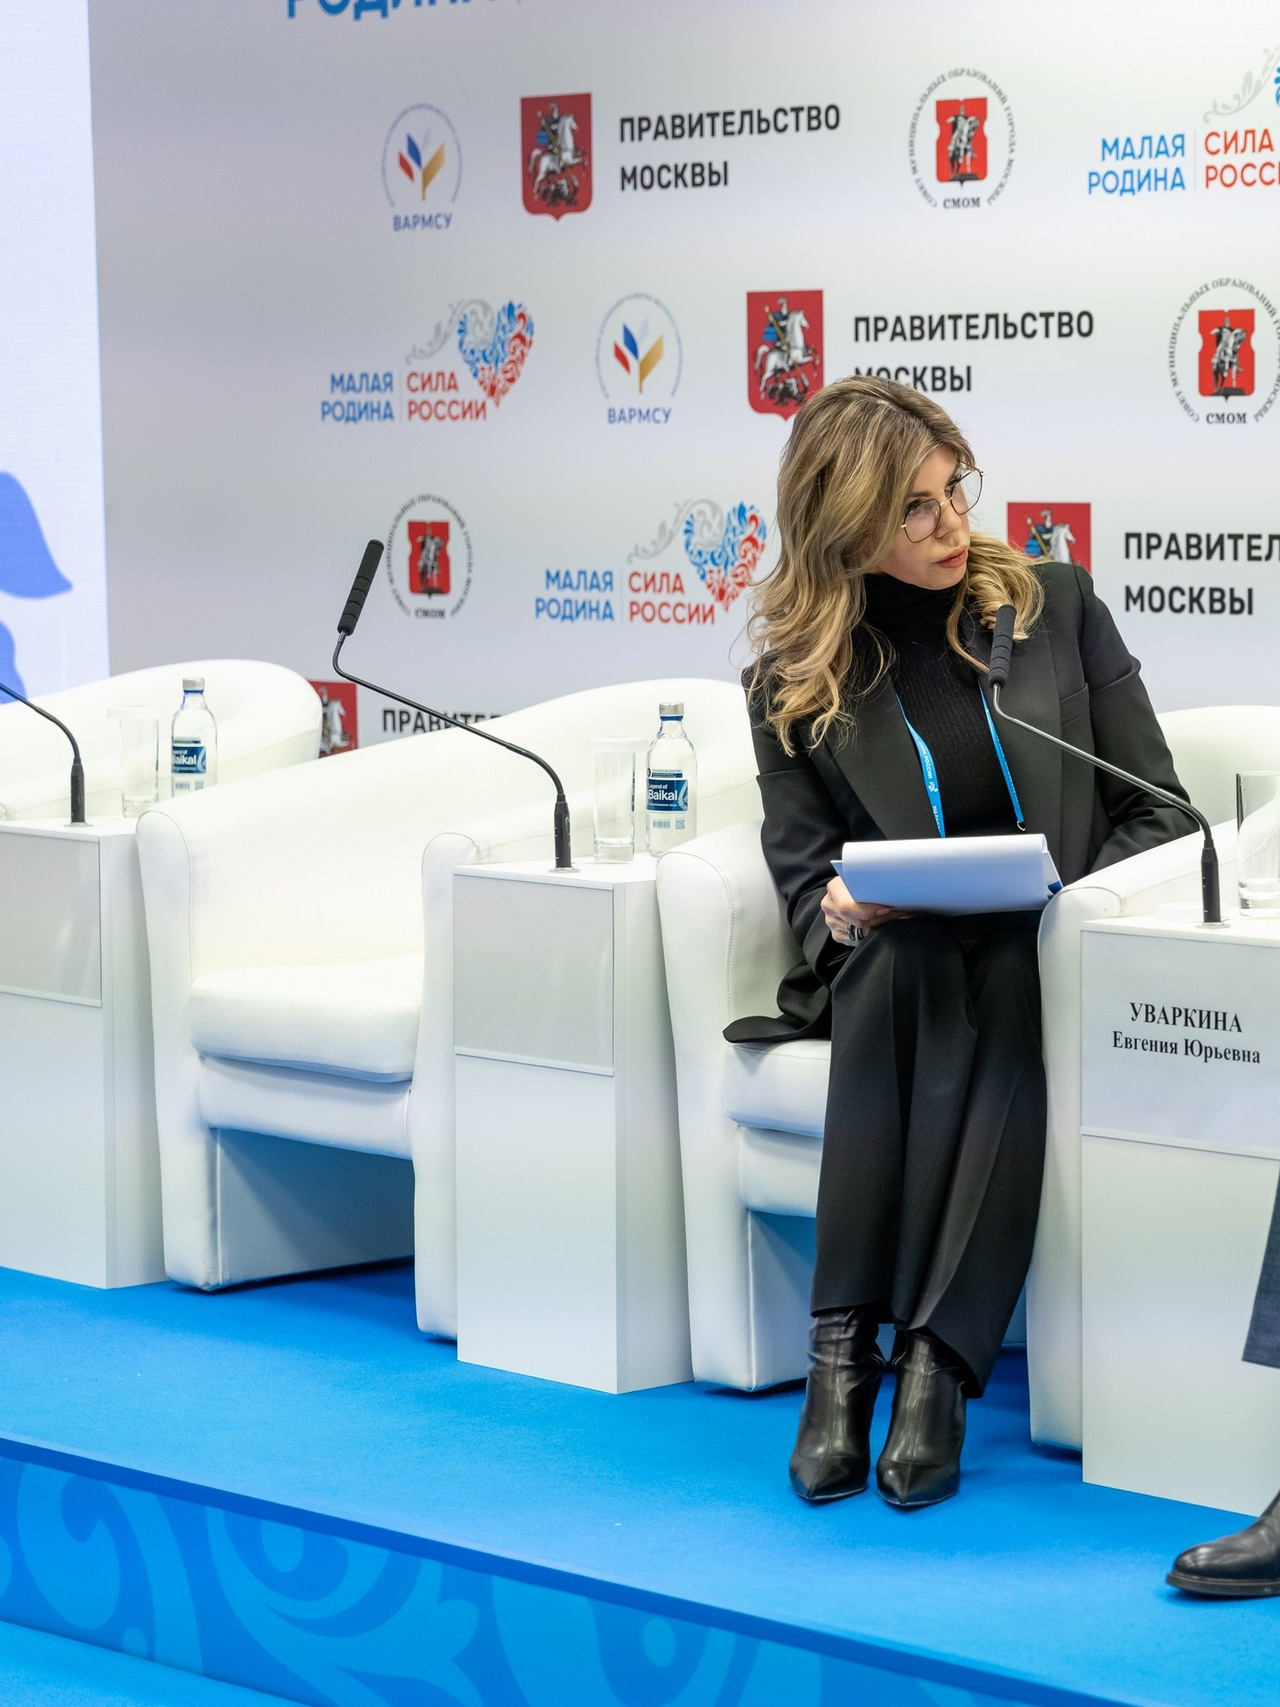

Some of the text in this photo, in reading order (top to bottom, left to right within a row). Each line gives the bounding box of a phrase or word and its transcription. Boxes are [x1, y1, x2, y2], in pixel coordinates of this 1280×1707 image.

[619, 104, 841, 143] ПРАВИТЕЛЬСТВО
[1101, 133, 1186, 162] МАЛАЯ
[1204, 128, 1275, 156] СИЛА
[620, 161, 729, 192] МОСКВЫ
[1088, 167, 1186, 197] РОДИНА
[943, 197, 980, 209] СМОМ
[854, 311, 1094, 343] ПРАВИТЕЛЬСТВО
[329, 372, 394, 394] МАЛАЯ
[406, 371, 459, 394] СИЛА
[320, 400, 395, 424] РОДИНА
[407, 399, 487, 422] РОССИИ
[607, 407, 672, 424] ВАРМСУ
[1206, 412, 1248, 424] СМОМ
[545, 569, 614, 592] МАЛАЯ
[628, 570, 685, 594] СИЛА
[535, 597, 615, 624] РОДИНА
[629, 600, 716, 625] РОССИИ
[1124, 585, 1254, 616] МОСКВЫ
[648, 790, 678, 801] Baikal
[1129, 1002, 1243, 1033] УВАРКИНА
[1112, 1031, 1261, 1064] Евгения Юрьевна
